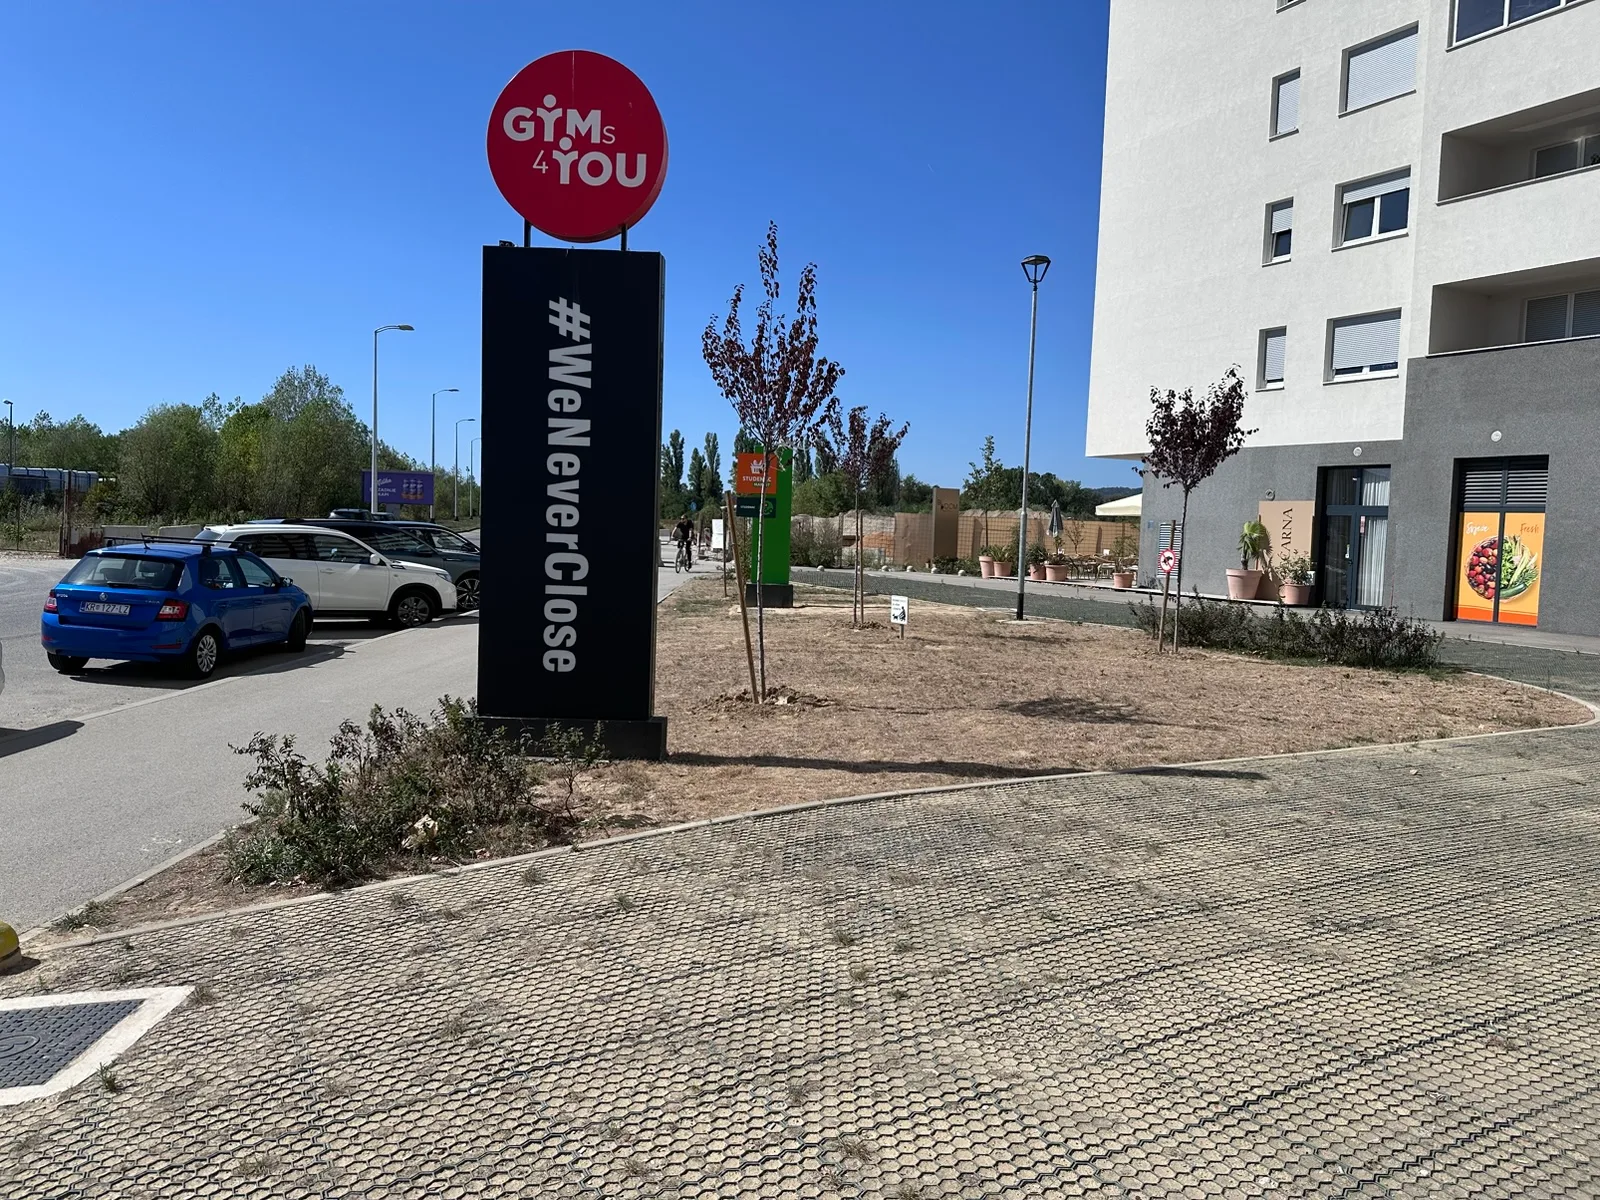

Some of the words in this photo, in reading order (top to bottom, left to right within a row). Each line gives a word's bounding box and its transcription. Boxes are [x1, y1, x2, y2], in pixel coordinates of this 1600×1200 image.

[542, 296, 592, 672] #WeNeverClose
[1520, 523, 1540, 534] Fresh
[86, 602, 96, 611] KR
